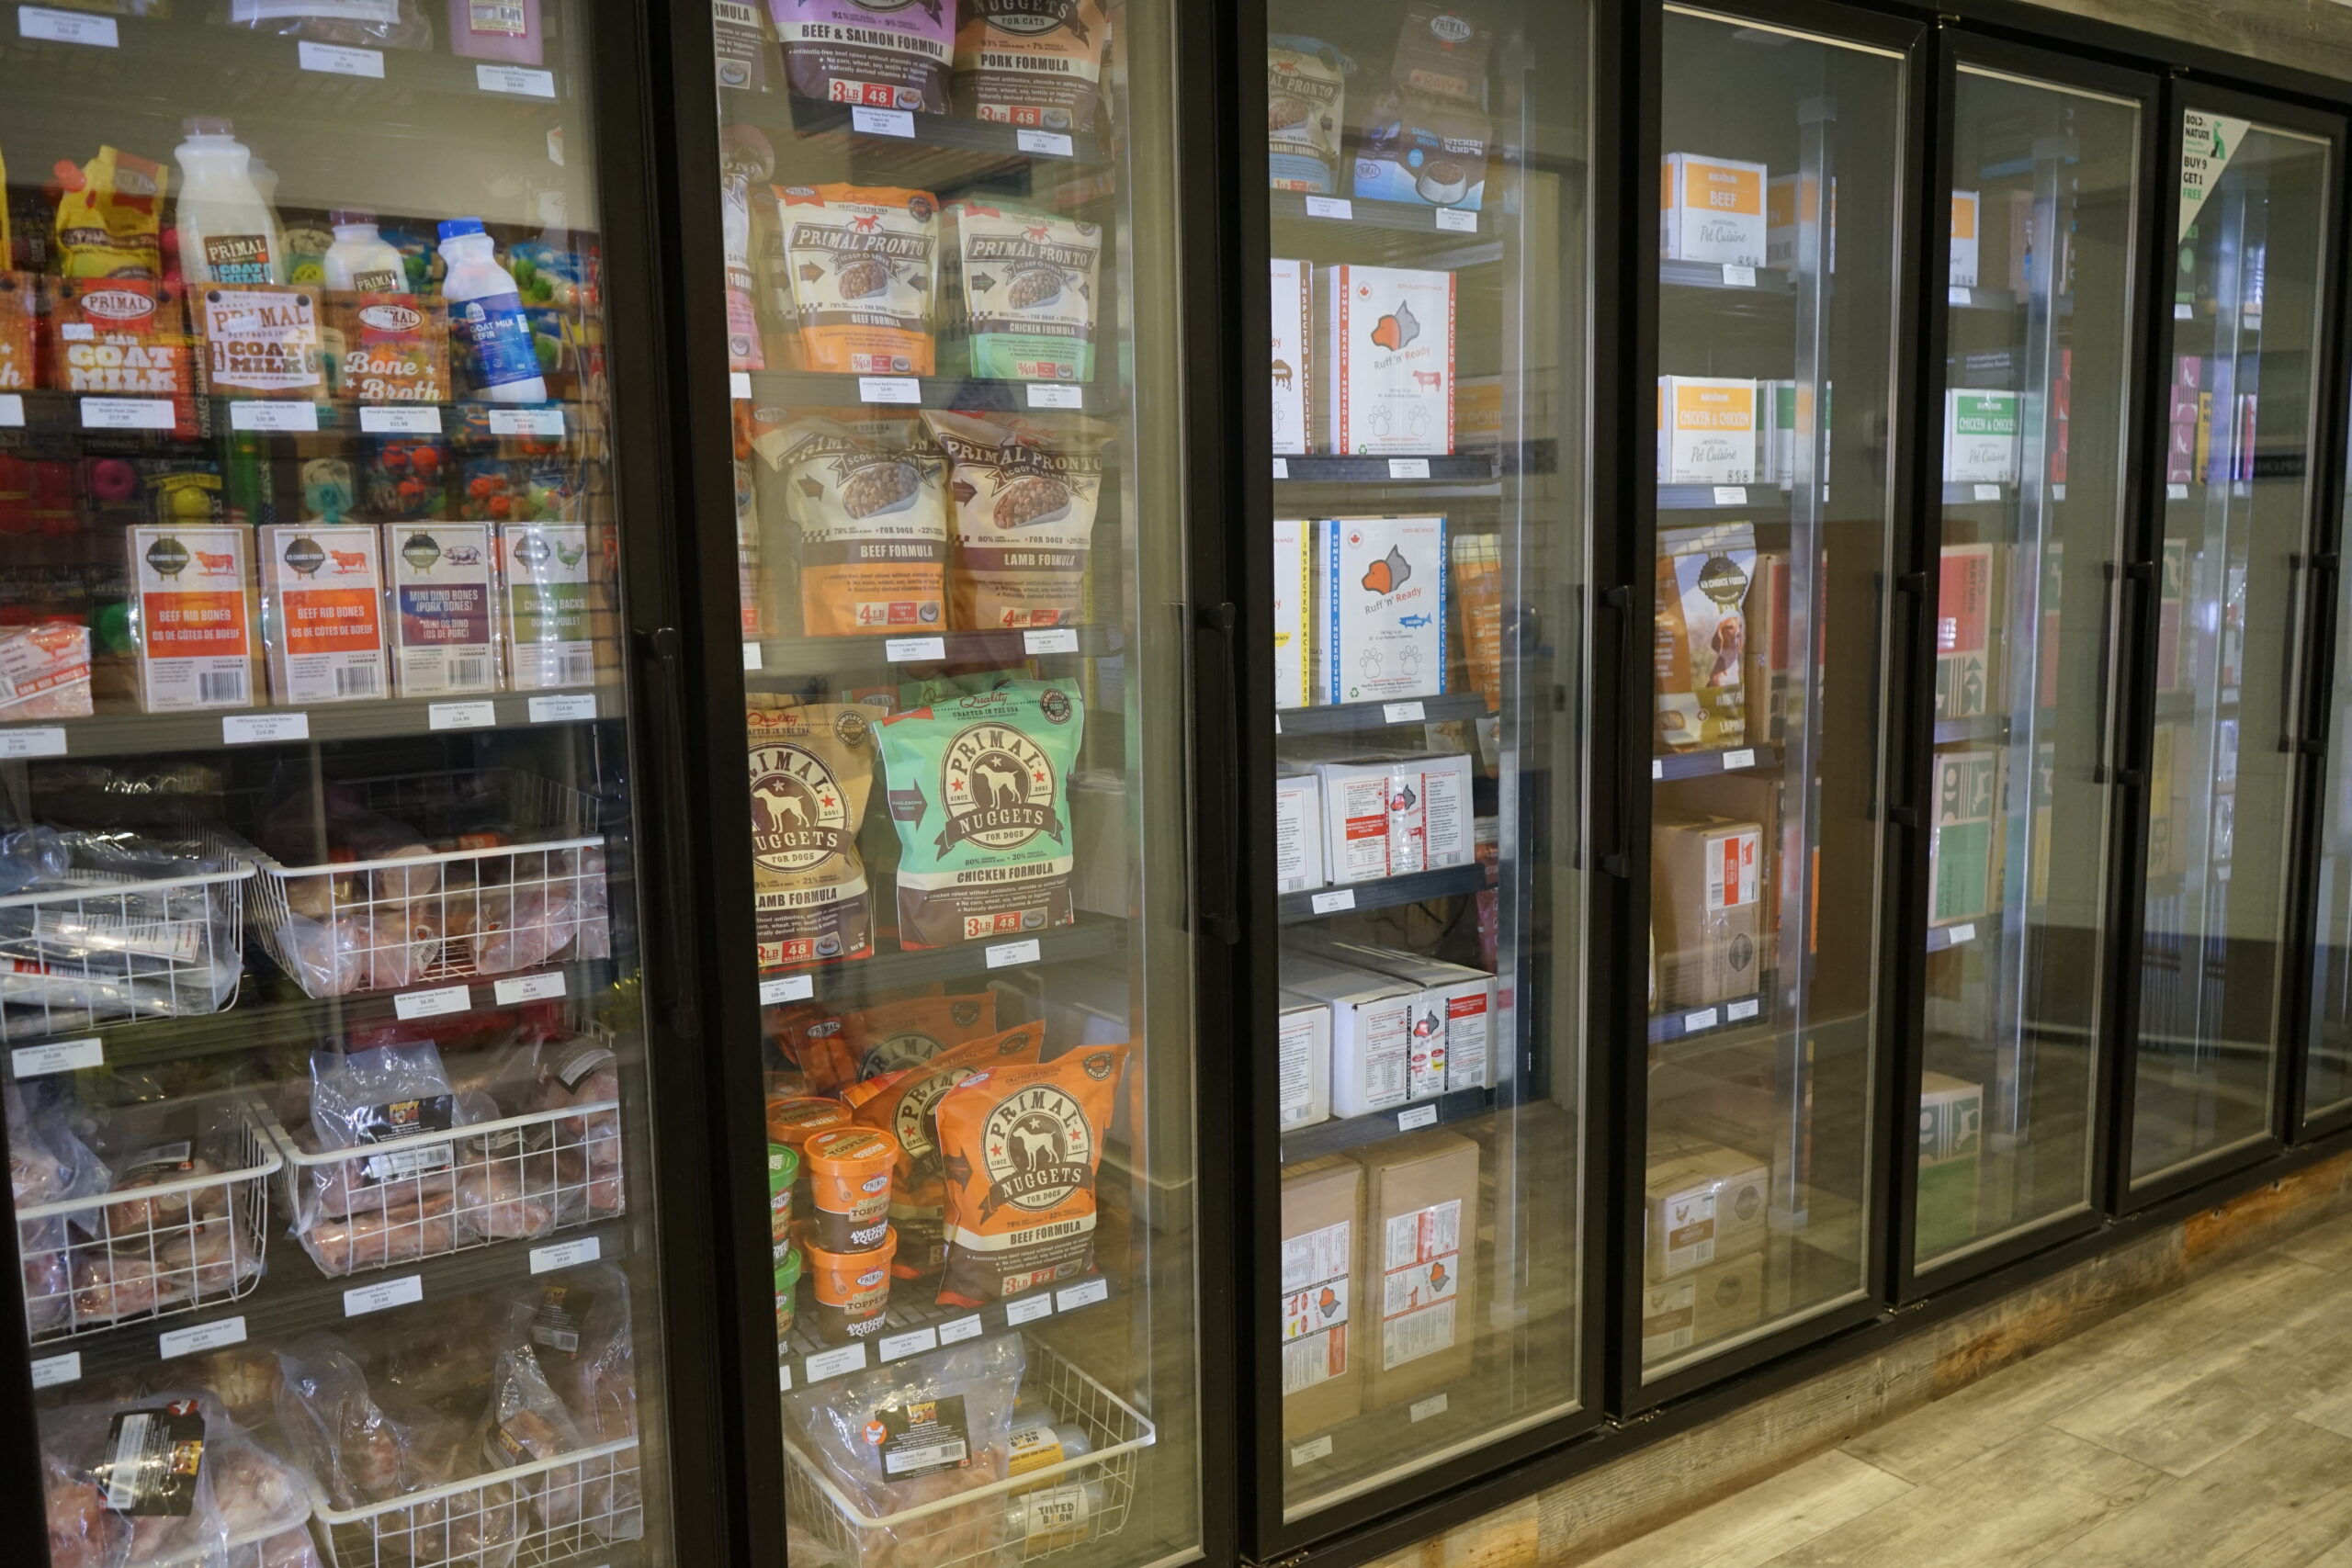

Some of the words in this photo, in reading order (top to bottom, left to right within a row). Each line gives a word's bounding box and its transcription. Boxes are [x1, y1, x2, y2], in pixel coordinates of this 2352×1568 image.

[1001, 17, 1021, 26] FOR
[1023, 17, 1046, 26] CATS
[1435, 18, 1468, 35] PRIMAL
[802, 24, 831, 39] BEEF
[834, 28, 843, 39] &
[846, 28, 895, 47] SALMON
[898, 37, 944, 58] FORMULA
[981, 53, 1012, 68] PORK
[1016, 56, 1069, 73] FORMULA
[1287, 78, 1334, 97] PRONTO
[868, 90, 888, 103] 48
[1016, 113, 1035, 124] 48
[2186, 115, 2203, 126] BOLD
[2185, 128, 2210, 141] NATURE
[2184, 157, 2201, 169] BUY
[2201, 160, 2208, 170] 9
[2183, 172, 2199, 184] GET
[1710, 190, 1737, 208] BEEF
[2182, 187, 2202, 200] FREE
[1700, 225, 1714, 243] Pet
[1716, 226, 1747, 243] Cuisine
[797, 230, 859, 251] PRIMAL
[863, 236, 924, 256] PRONTO
[209, 240, 266, 262] PRIMAL
[972, 242, 1035, 257] PRIMAL
[1039, 246, 1088, 266] PRONTO
[90, 296, 146, 310] PRIMAL
[469, 321, 493, 333] GOAT
[495, 319, 514, 329] MILK
[851, 313, 869, 323] BEEF
[871, 315, 901, 327] FORMULA
[1010, 322, 1041, 333] CHICKEN
[1042, 324, 1075, 335] FORMULA
[471, 331, 495, 342] KEFIR
[68, 344, 175, 368] GOAT
[228, 341, 301, 357] GOAT
[344, 351, 418, 376] Bone
[1374, 355, 1393, 371] Ruff
[1394, 353, 1404, 364] 'n'
[1405, 345, 1431, 361] Ready
[230, 357, 302, 374] MILK
[69, 367, 178, 392] MILK
[359, 378, 444, 400] Broth
[1303, 364, 1312, 447] FACILITIES
[1680, 411, 1710, 426] CHICKEN
[1719, 411, 1750, 427] CHICKEN
[1959, 417, 1985, 431] CHICKEN
[947, 440, 1026, 466] PRIMAL
[1031, 451, 1102, 472] PRONTO
[1690, 446, 1705, 464] Pet
[1709, 446, 1737, 462] Cuisine
[879, 526, 895, 535] FOR
[896, 526, 914, 535] DOGS
[1029, 536, 1044, 544] FOR
[860, 545, 887, 558] BEEF
[889, 545, 933, 558] FORMULA
[1004, 553, 1035, 566] LAMB
[1038, 554, 1076, 567] FORMULA
[1708, 577, 1728, 588] CHOICE
[1729, 574, 1747, 586] FOODS
[410, 590, 430, 603] MINI
[430, 590, 450, 602] DINO
[452, 589, 479, 601] BONES
[559, 597, 586, 609] BACKS
[1364, 600, 1384, 615] Ruff
[1384, 596, 1395, 607] 'n'
[1396, 586, 1422, 604] Ready
[297, 607, 318, 620] BEEF
[320, 607, 334, 619] RIB
[336, 605, 365, 618] BONES
[416, 601, 442, 613] (PORK
[443, 600, 473, 612] BONES)
[159, 610, 181, 622] BEEF
[183, 610, 199, 622] RIB
[201, 608, 232, 622] BONES
[556, 616, 581, 626] POULET
[451, 618, 469, 628] DINO
[164, 630, 176, 641] DE
[204, 629, 215, 639] DE
[215, 628, 241, 639] BOEUF
[303, 626, 314, 637] DE
[339, 626, 350, 636] DE
[350, 624, 374, 635] BOEUF
[437, 629, 447, 638] DE
[447, 628, 469, 638] PORC)
[960, 692, 1010, 709] Quality
[747, 712, 799, 728] Quality
[952, 709, 983, 717] CRAFTED
[951, 730, 1041, 775] PRIMAL
[1035, 784, 1048, 793] 2001
[823, 808, 840, 817] 2001
[958, 808, 1044, 835] NUGGETS
[986, 832, 1001, 841] FOR
[1003, 829, 1024, 840] DOGS
[771, 854, 790, 863] FOR
[792, 852, 815, 862] DOGS
[965, 858, 980, 866] 80%
[1012, 852, 1026, 861] 20%
[957, 868, 1006, 884] CHICKEN
[1009, 863, 1054, 879] FORMULA
[789, 887, 838, 906] FORMULA
[969, 889, 989, 897] without
[963, 905, 988, 913] Naturally
[999, 919, 1015, 929] 48
[788, 944, 808, 955] 48
[784, 953, 811, 962] NUGGETS
[809, 1021, 840, 1036] PRIMAL
[990, 1091, 1077, 1140] PRIMAL
[991, 1158, 1007, 1167] SINCE
[865, 1179, 887, 1190] PRIMAL
[1001, 1168, 1082, 1198] NUGGETS
[1026, 1194, 1042, 1203] FOR
[1043, 1190, 1061, 1201] DOGS
[854, 1229, 887, 1245] SQUASH
[1011, 1229, 1034, 1246] BEEF
[1035, 1220, 1081, 1241] FORMULA
[861, 1271, 883, 1284] PRIMAL
[1035, 1272, 1051, 1283] 48
[850, 1321, 885, 1337] SQUASH
